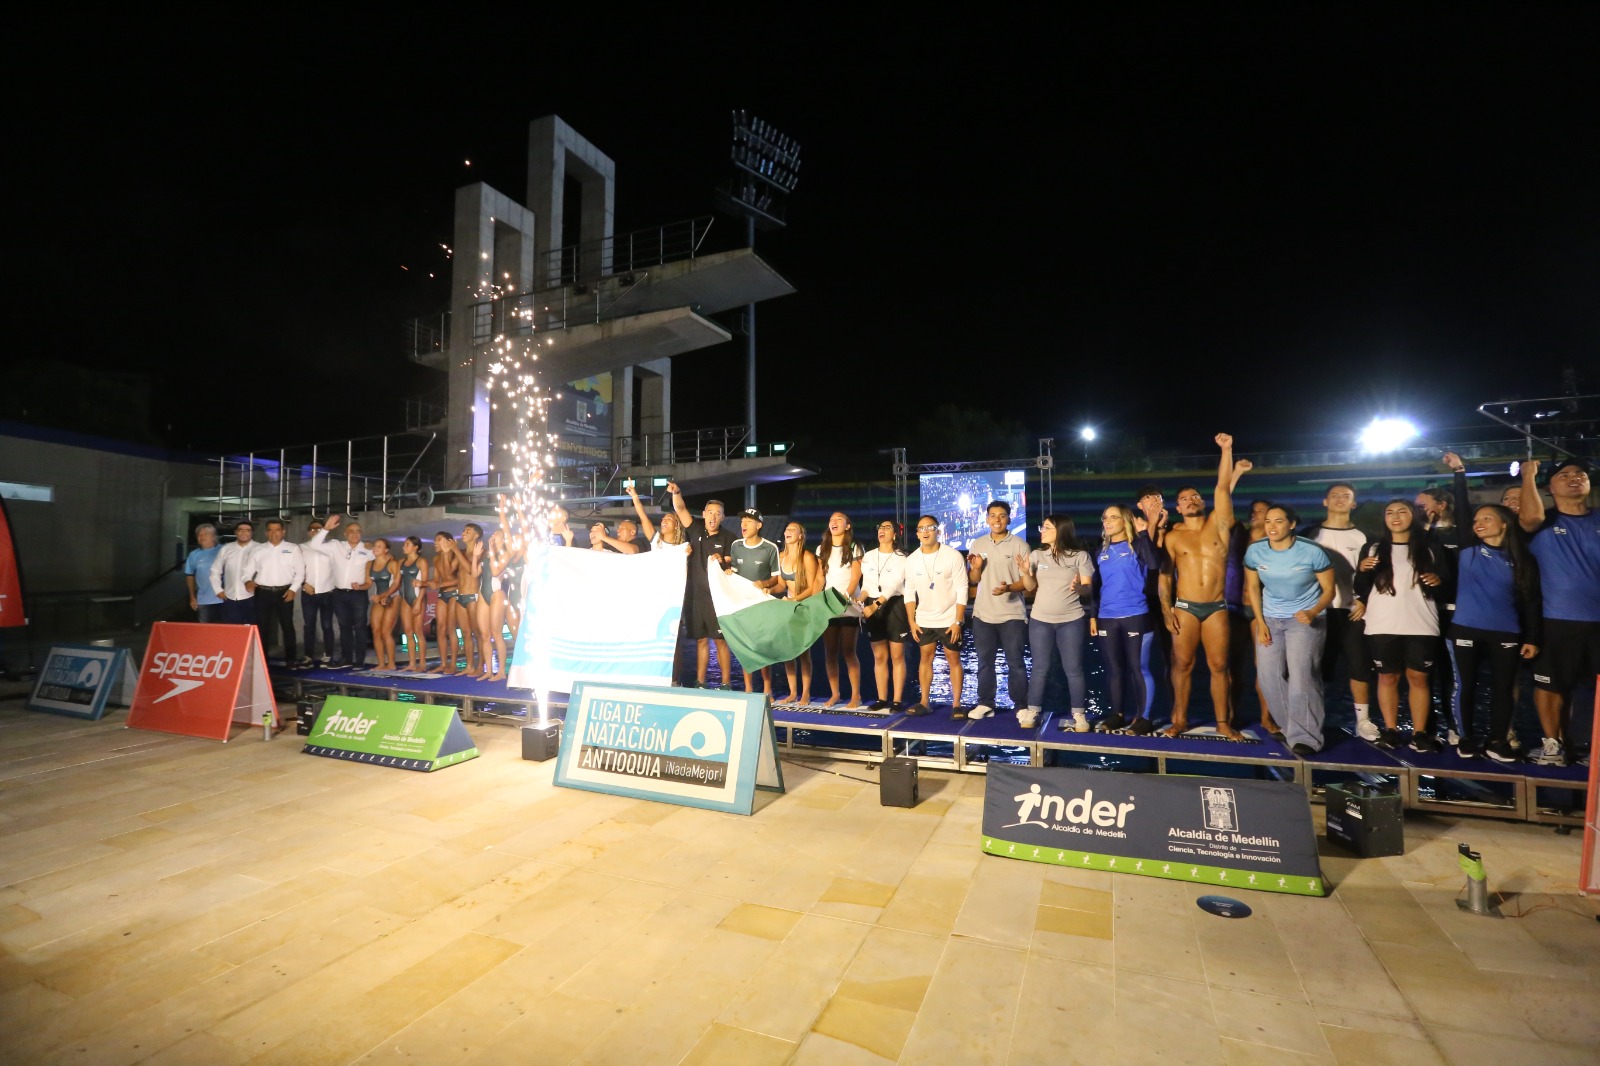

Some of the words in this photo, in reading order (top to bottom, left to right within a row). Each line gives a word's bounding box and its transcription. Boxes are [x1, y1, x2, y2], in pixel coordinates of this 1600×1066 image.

[149, 650, 233, 679] speedo
[323, 709, 378, 735] inder
[590, 701, 621, 723] LIGA
[624, 704, 643, 725] DE
[586, 721, 668, 752] NATACIÓN
[582, 747, 661, 778] ANTIOQUIA
[664, 760, 723, 784] ¡NadaMejor!
[1014, 783, 1136, 829] inder
[1168, 845, 1196, 855] Ciencia,
[1214, 832, 1229, 843] de
